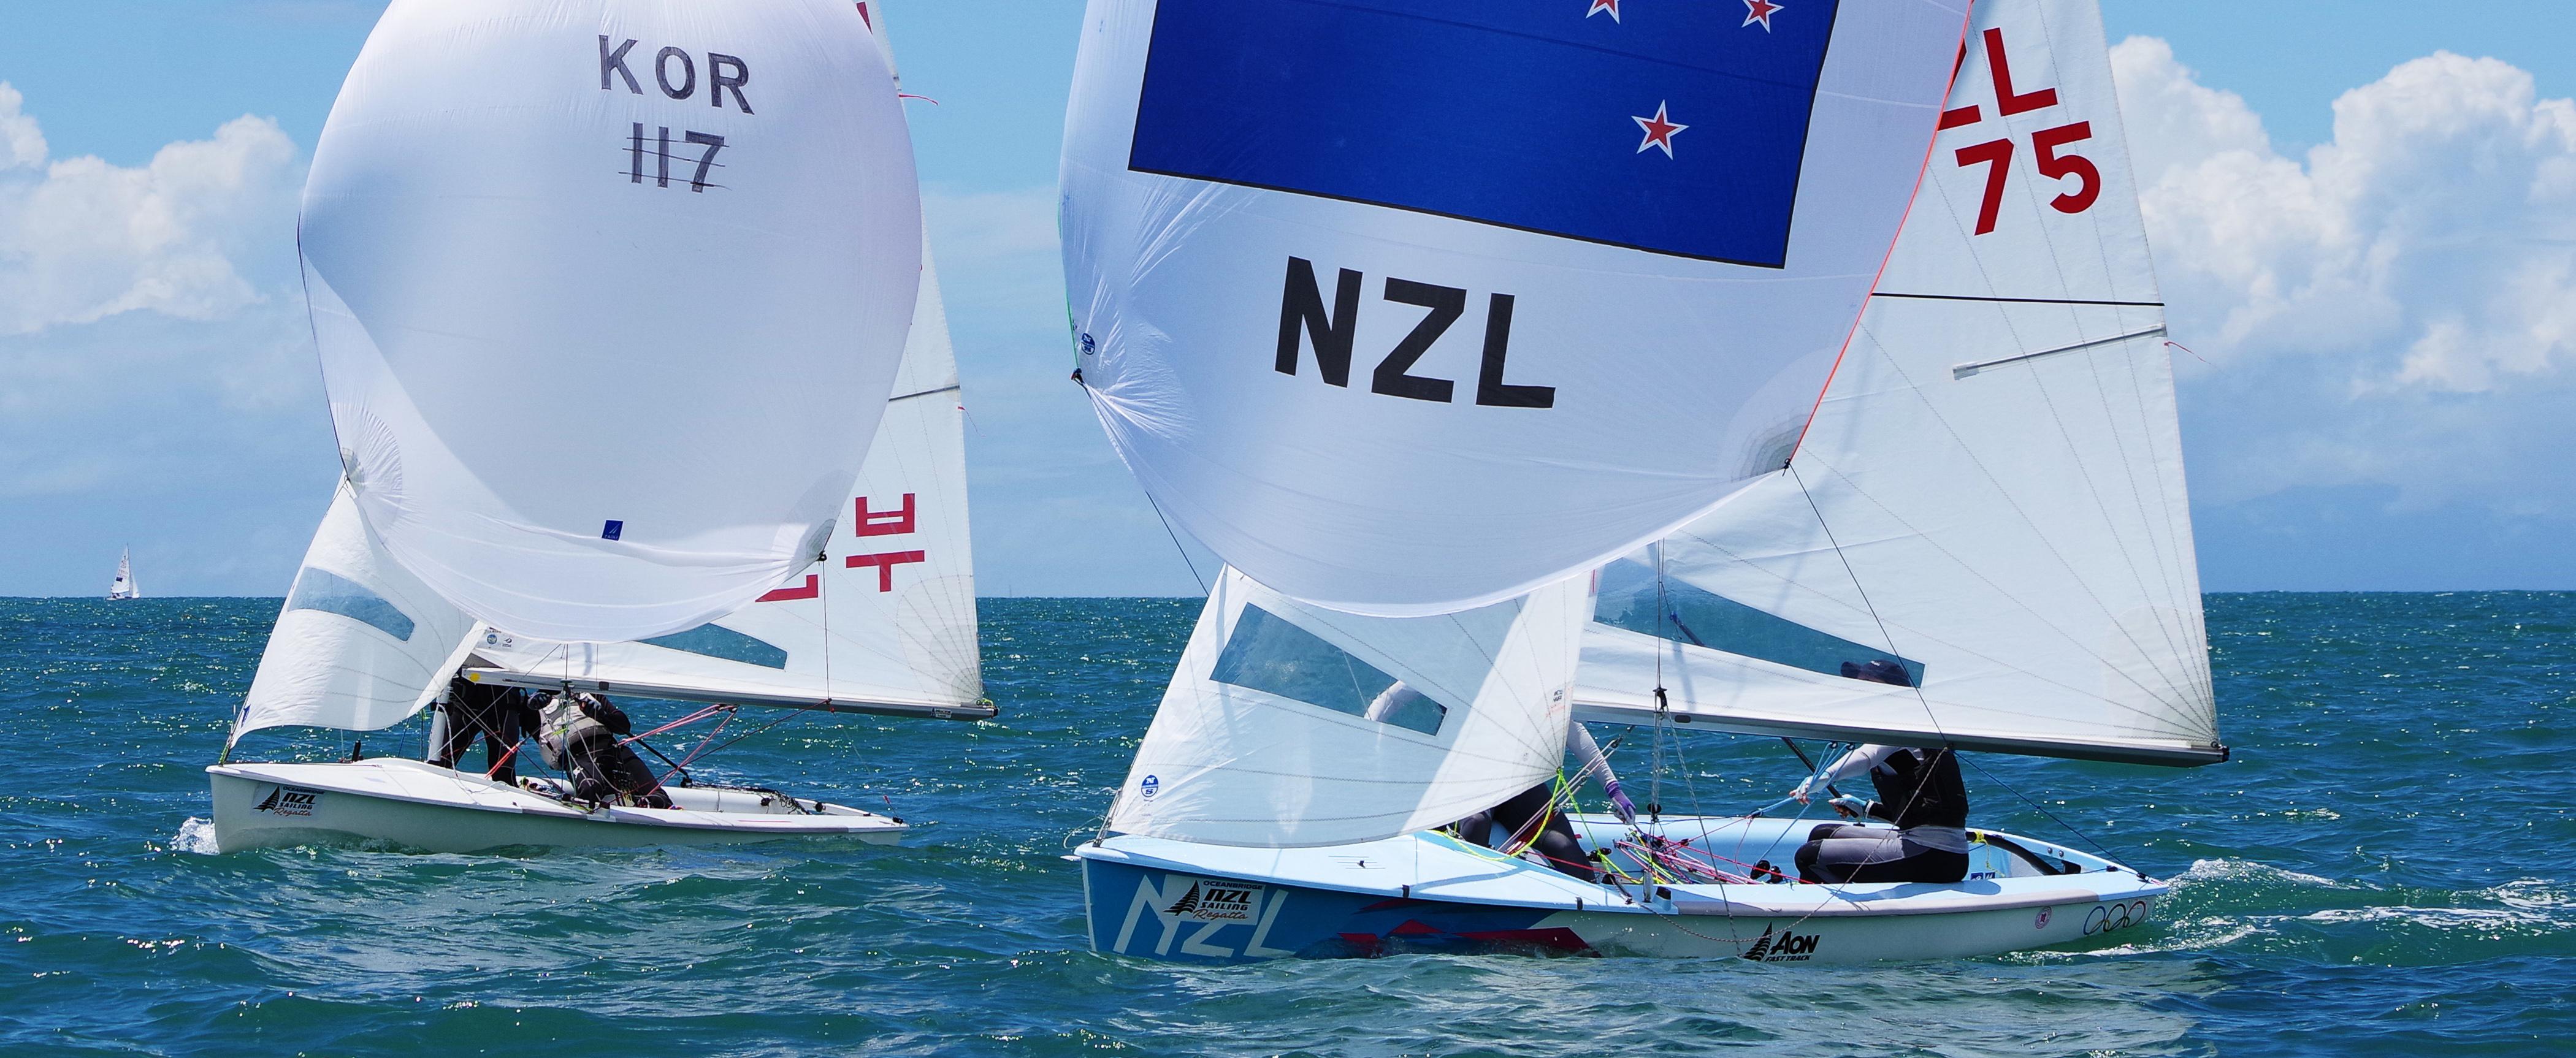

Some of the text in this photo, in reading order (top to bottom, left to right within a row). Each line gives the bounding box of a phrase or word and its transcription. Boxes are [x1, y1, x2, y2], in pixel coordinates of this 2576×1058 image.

[598, 34, 754, 115] KOR
[631, 122, 725, 193] 117
[1954, 120, 2101, 236] 75
[1275, 255, 1556, 409] NZL
[273, 807, 312, 816] Regatta
[1113, 874, 1297, 958] NZL
[1193, 908, 1248, 920] Regatta
[1200, 902, 1248, 911] SAILING
[1203, 880, 1263, 890] OCEANBRIDGE
